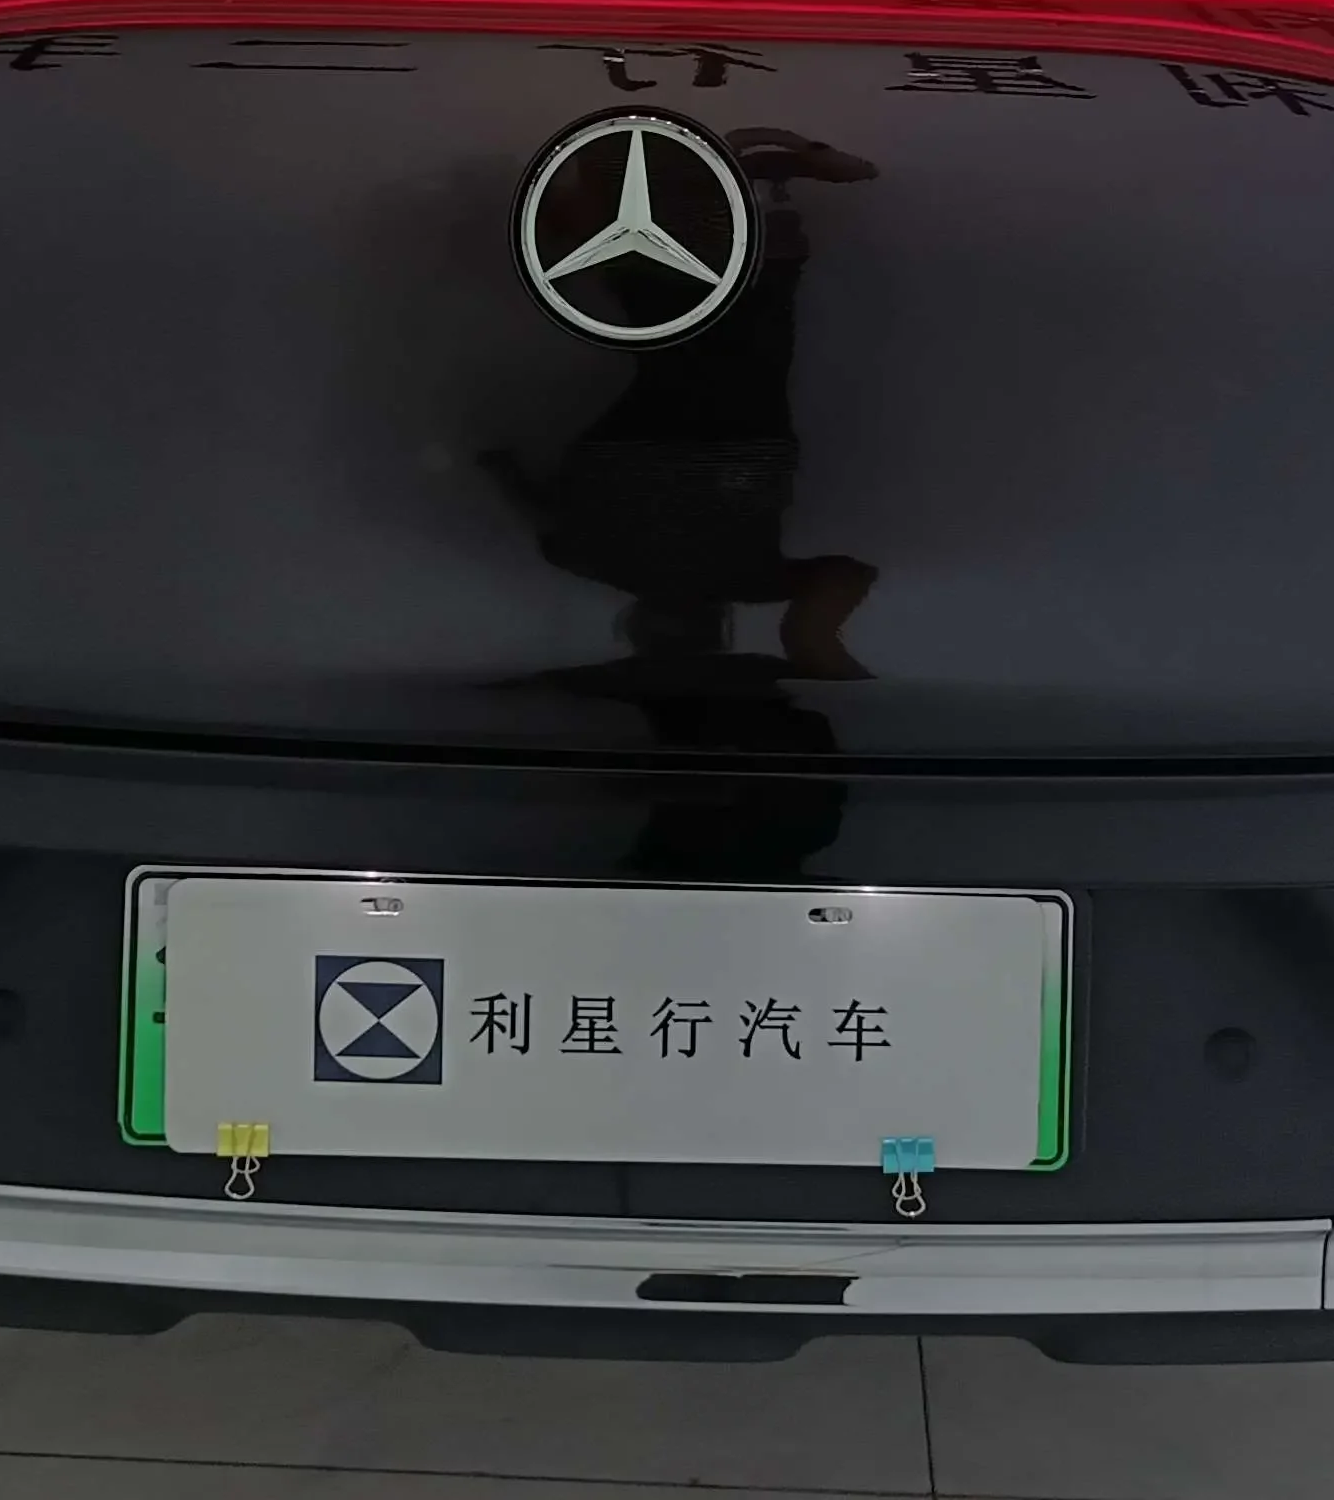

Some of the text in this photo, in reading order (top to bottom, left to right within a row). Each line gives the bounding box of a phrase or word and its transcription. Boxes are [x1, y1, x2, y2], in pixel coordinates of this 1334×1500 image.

[469, 992, 893, 1062] 利星行汽车
